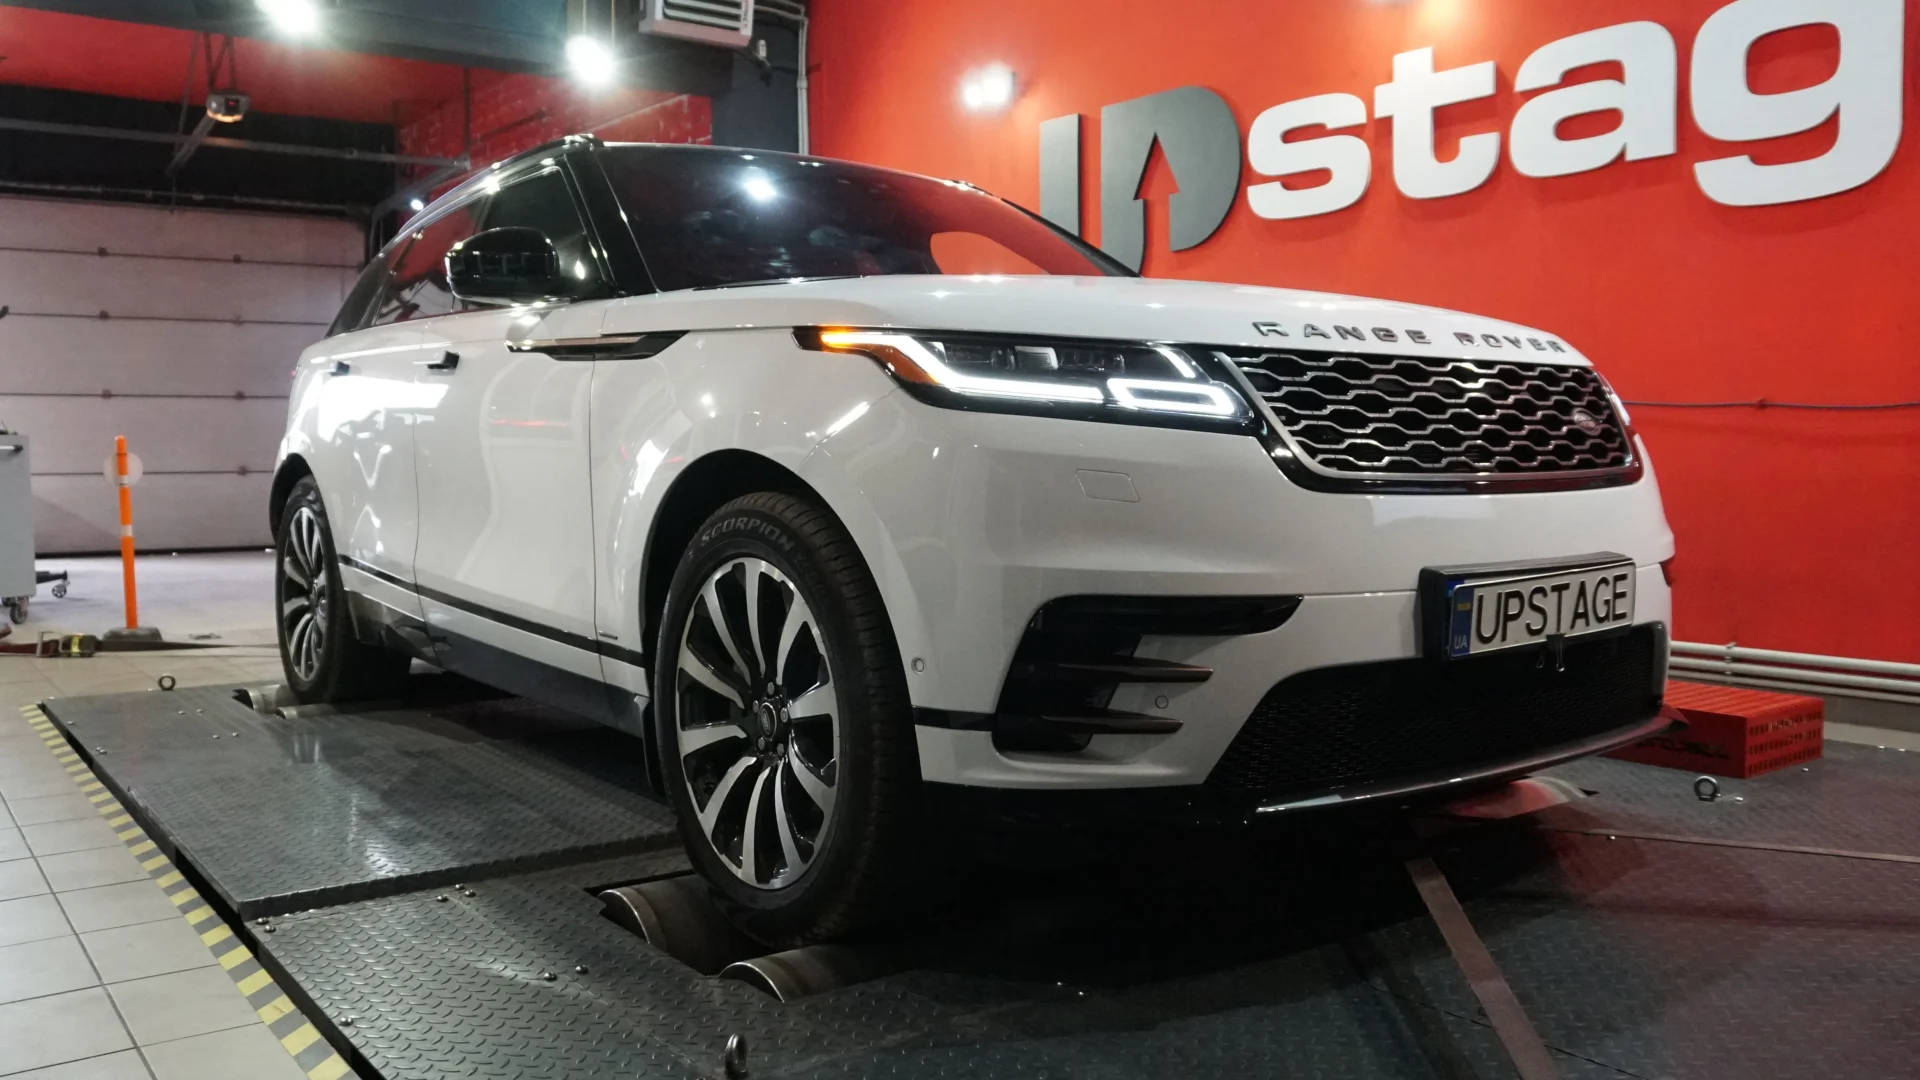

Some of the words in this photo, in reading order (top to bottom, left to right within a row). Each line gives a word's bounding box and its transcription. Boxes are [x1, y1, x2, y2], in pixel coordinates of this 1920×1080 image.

[1252, 321, 1432, 345] RANGE
[1452, 331, 1567, 353] ROVER
[700, 517, 795, 551] SCORPION
[1476, 573, 1628, 645] UPSTAGE
[1453, 635, 1468, 650] UA
